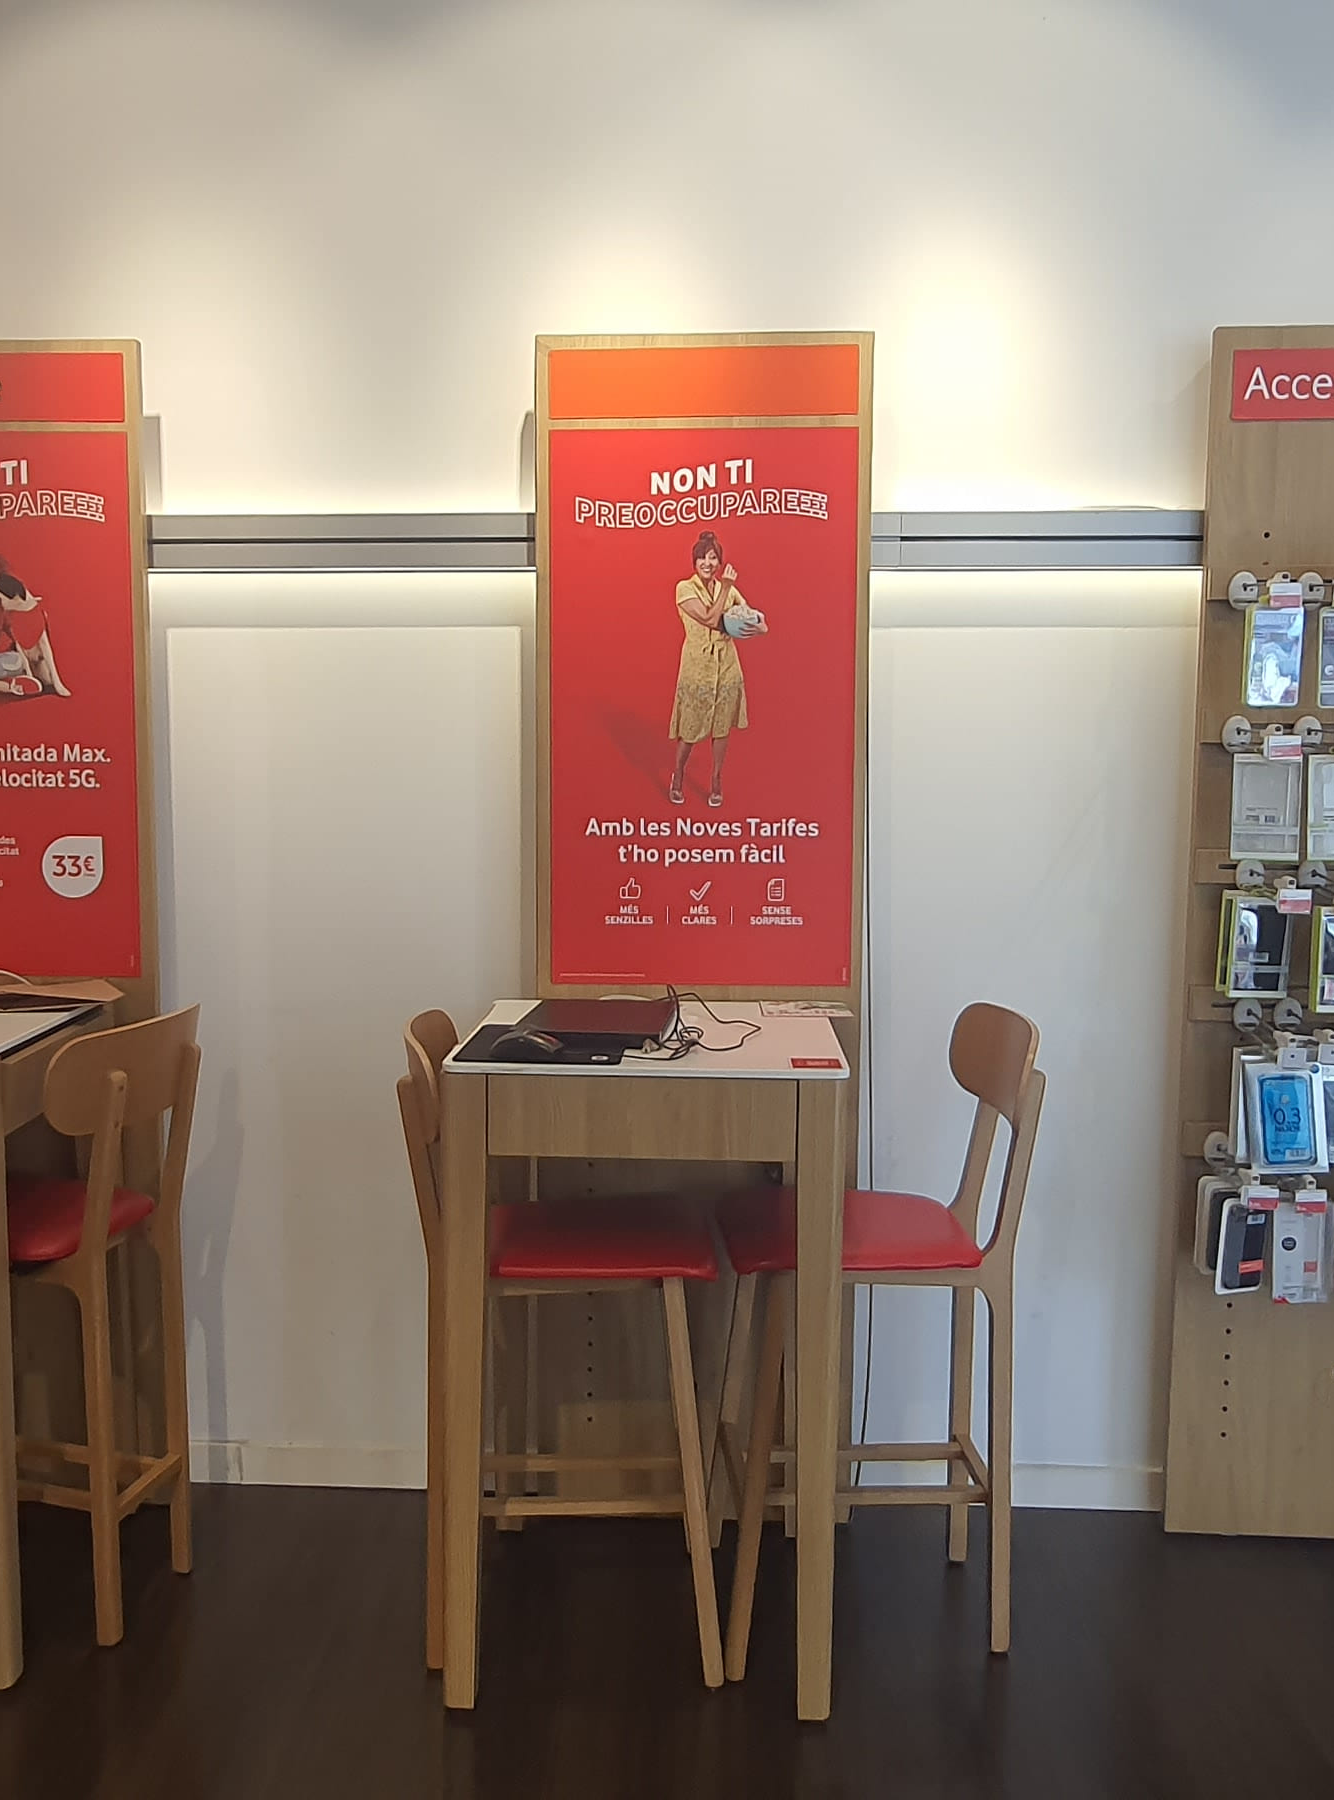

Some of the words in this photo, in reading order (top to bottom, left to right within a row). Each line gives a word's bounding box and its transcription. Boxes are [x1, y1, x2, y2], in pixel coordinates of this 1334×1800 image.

[0, 459, 29, 486] TI
[650, 463, 716, 496] NON
[725, 458, 753, 485] TI
[62, 743, 112, 763] Max.
[68, 769, 101, 789] 5G.
[585, 817, 635, 837] Amb
[640, 817, 671, 837] les
[676, 818, 742, 838] Noves
[746, 817, 820, 838] Tarifes
[618, 844, 659, 864] t'ho
[664, 848, 735, 867] posem
[740, 844, 786, 864] fàcil
[51, 854, 95, 878] 33€
[619, 904, 639, 915] MÉS
[689, 904, 710, 915] MÉS
[761, 905, 792, 915] SENSE
[604, 915, 654, 925] SENZILLES
[681, 915, 718, 926] CLARES
[750, 915, 804, 926] SORPRESES
